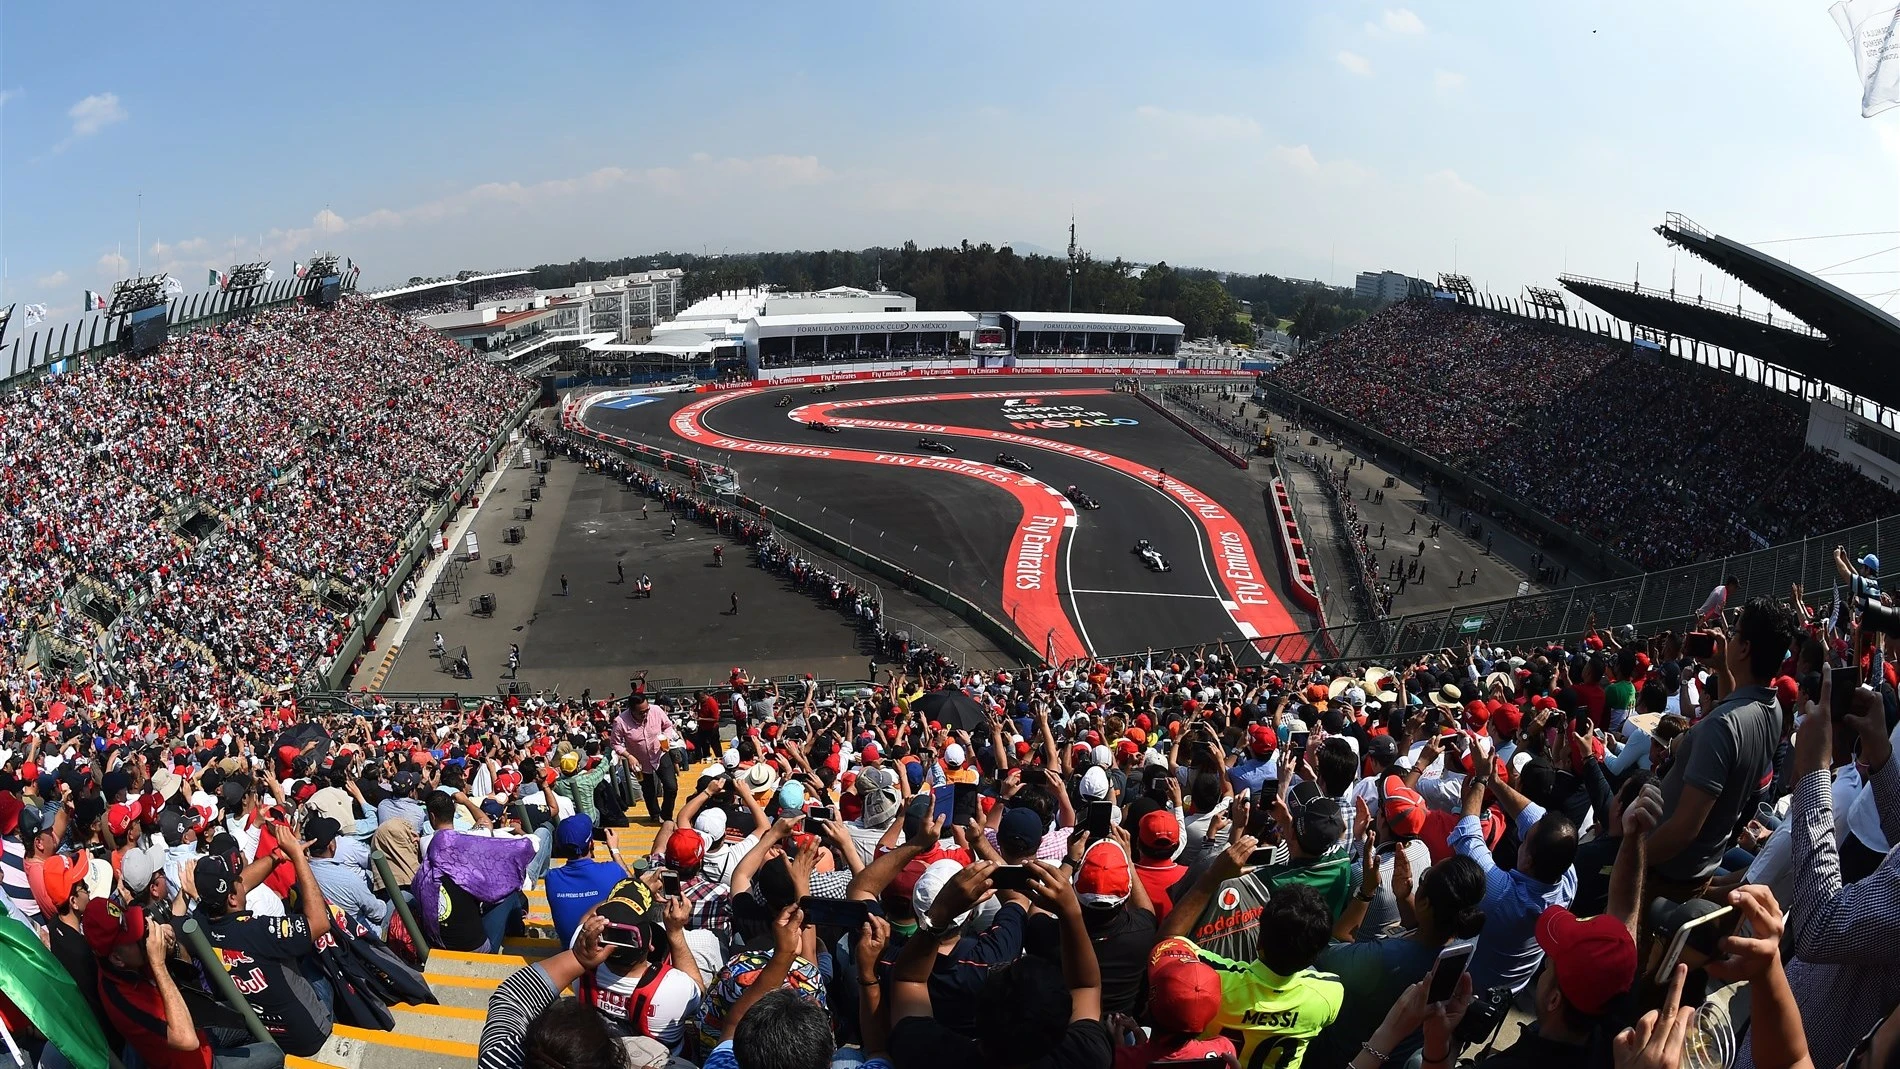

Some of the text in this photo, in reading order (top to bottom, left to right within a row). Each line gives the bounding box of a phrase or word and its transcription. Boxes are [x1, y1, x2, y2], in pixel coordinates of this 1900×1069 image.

[886, 323, 907, 331] CLUB
[821, 372, 857, 382] Fly Emirates
[882, 369, 907, 377] Emirates
[726, 381, 753, 389] Emirates
[768, 376, 806, 386] Fly Emirates
[867, 395, 938, 405] Emirates
[911, 423, 947, 432] Fly
[713, 438, 832, 457] Fly Emirates
[991, 432, 1111, 462] Fly Emirates
[874, 454, 1012, 483] Fly Emirates
[1196, 504, 1226, 520] Fly
[1015, 515, 1058, 590] Fly Emirates
[1219, 531, 1269, 605] Fly Emirates
[584, 890, 599, 898] MÉXICO
[231, 967, 269, 995] Bull
[1241, 1009, 1299, 1028] MESSI
